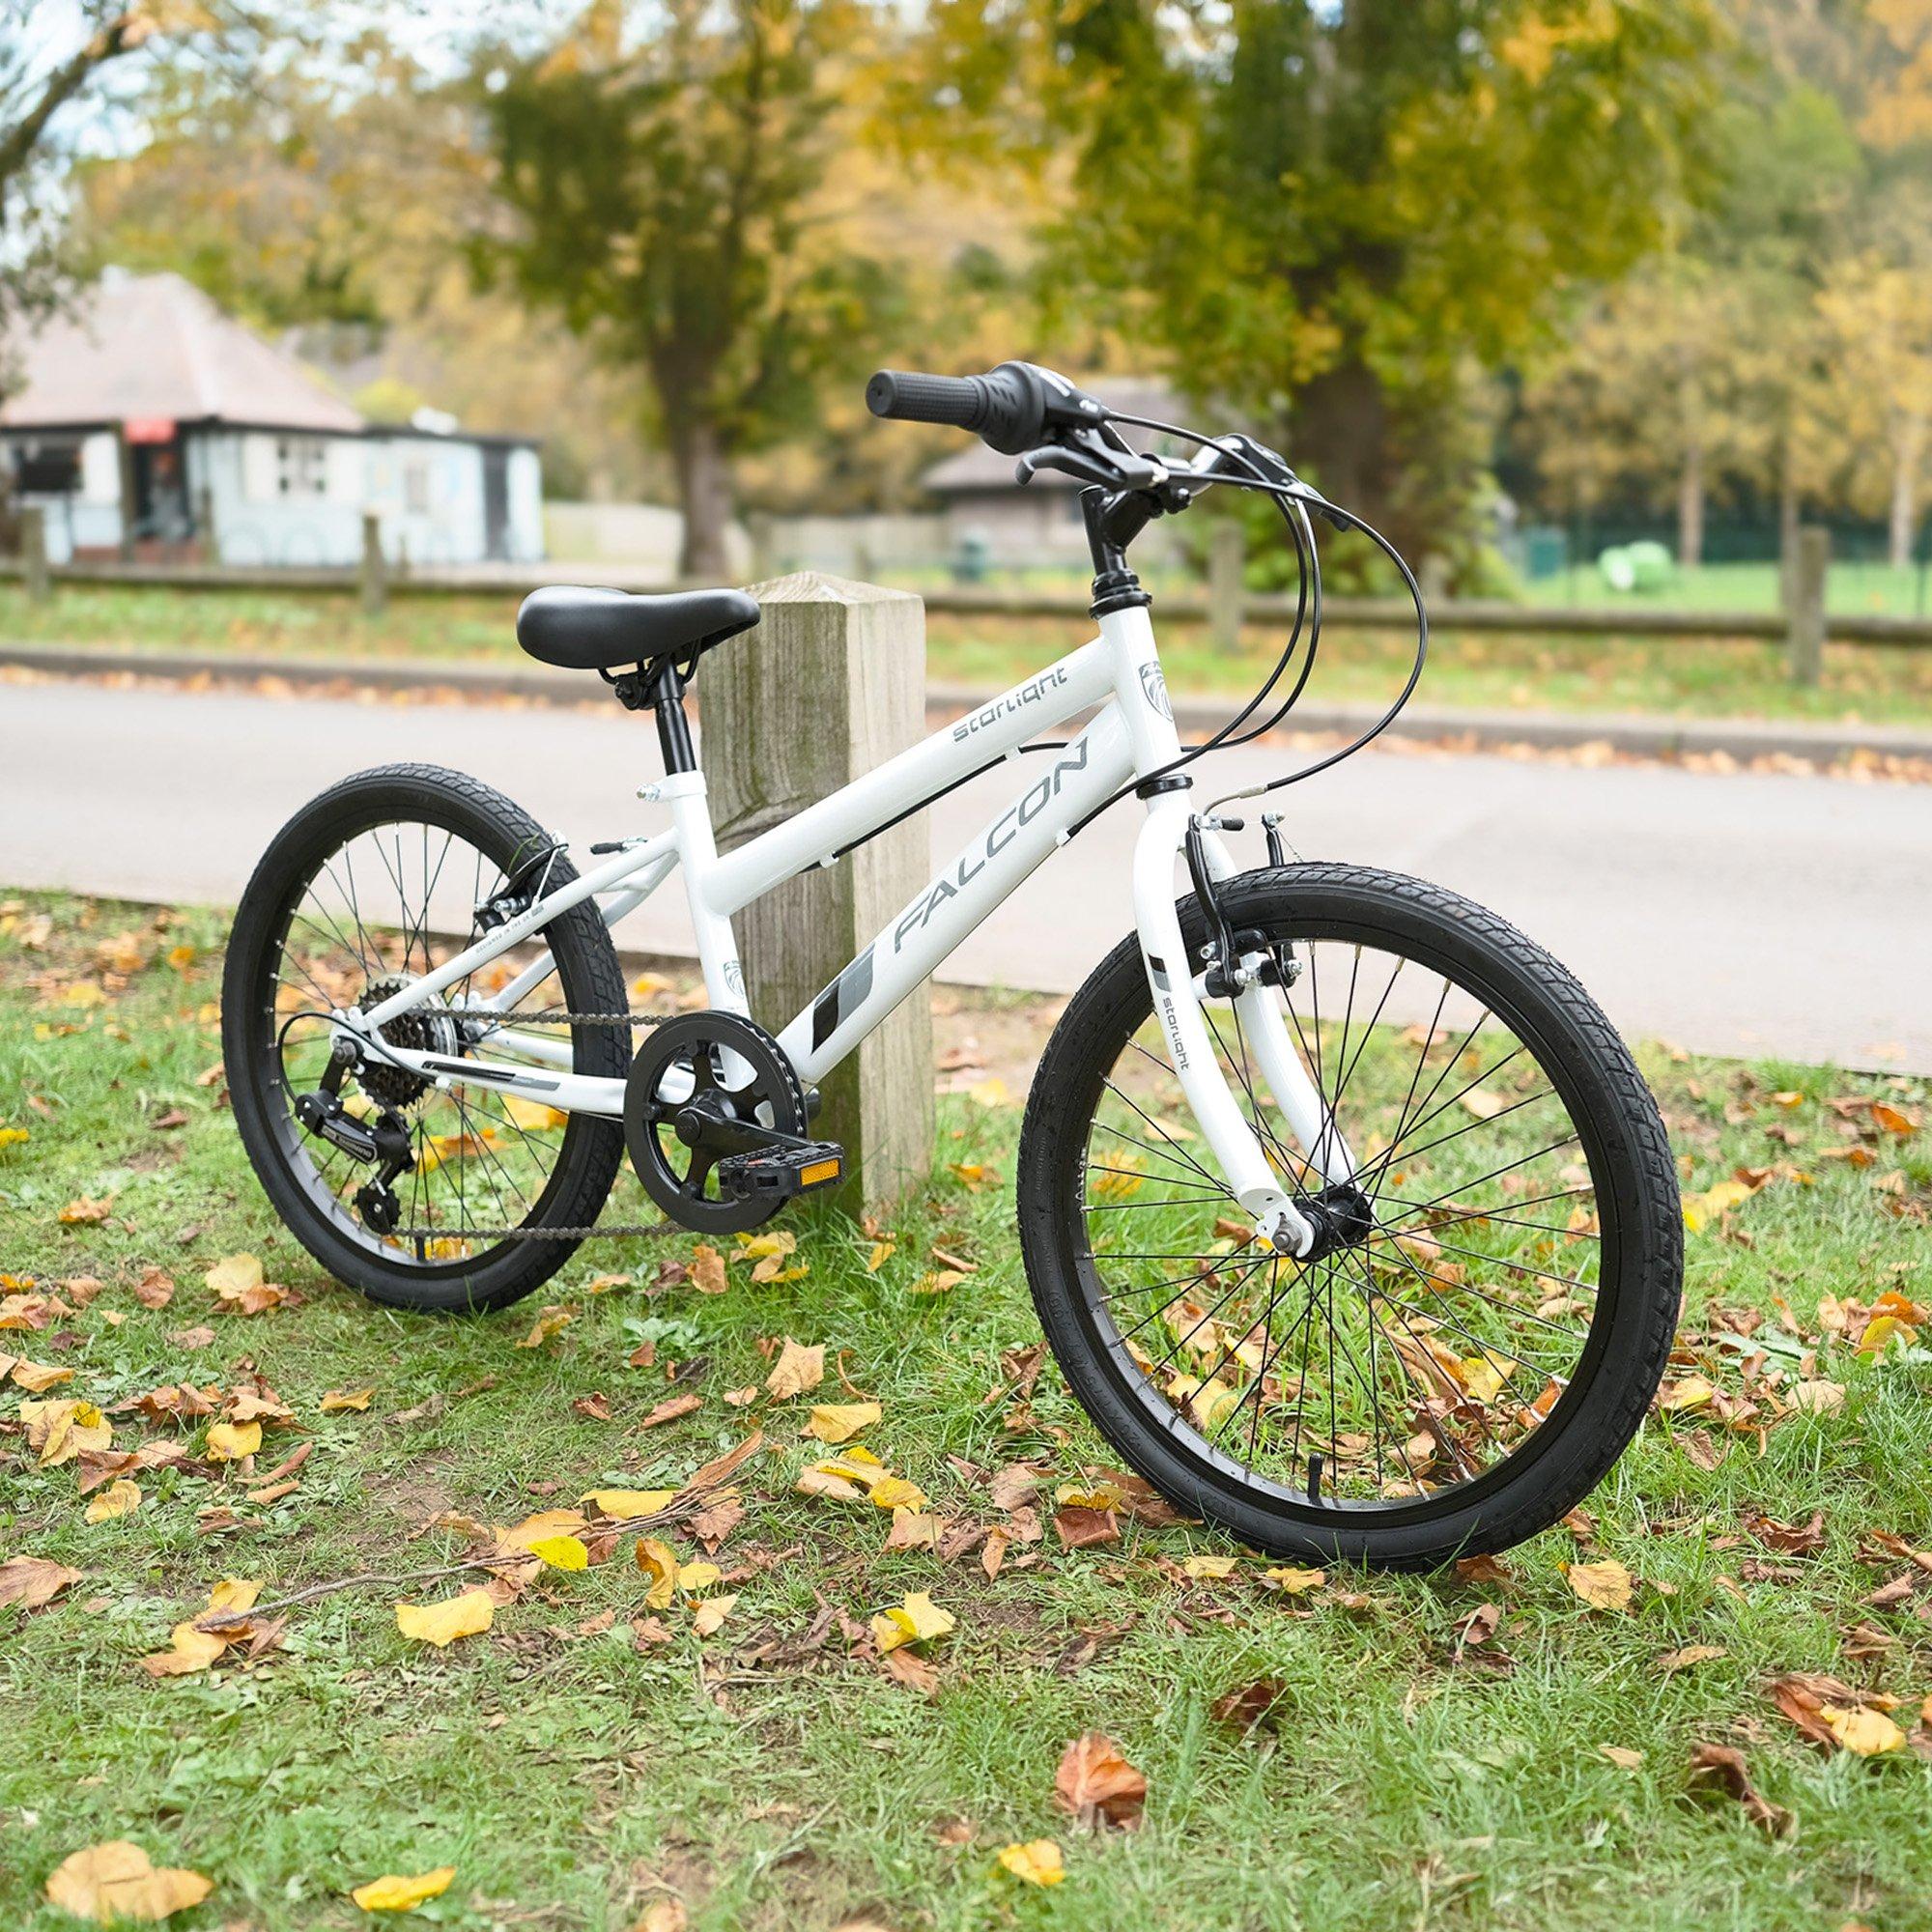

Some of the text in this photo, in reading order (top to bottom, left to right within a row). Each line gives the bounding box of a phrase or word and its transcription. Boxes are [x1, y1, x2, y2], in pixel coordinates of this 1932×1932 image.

[952, 667, 1068, 744] starlight
[893, 736, 1089, 954] FALCON
[1163, 997, 1190, 1070] starlight
